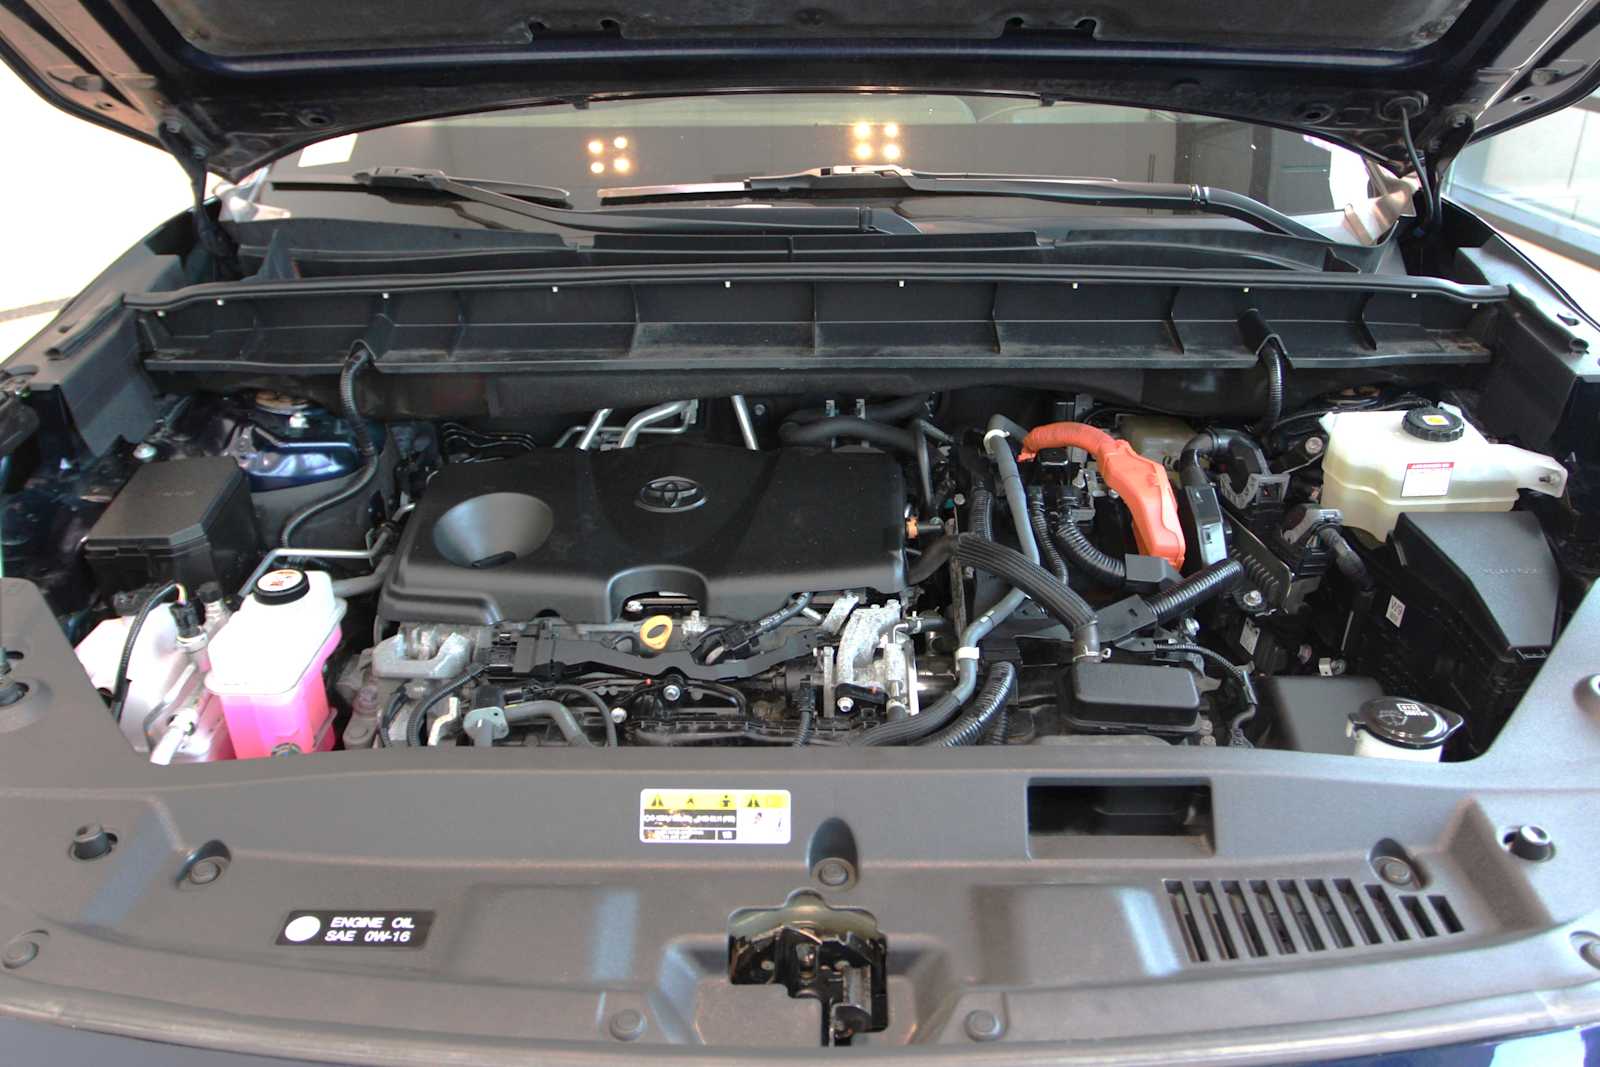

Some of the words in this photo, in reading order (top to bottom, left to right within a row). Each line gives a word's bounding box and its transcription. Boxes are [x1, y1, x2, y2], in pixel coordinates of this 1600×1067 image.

[331, 917, 385, 928] ENGINE
[392, 917, 415, 928] OIL
[325, 930, 356, 941] SAE
[364, 930, 411, 942] 0W-16
